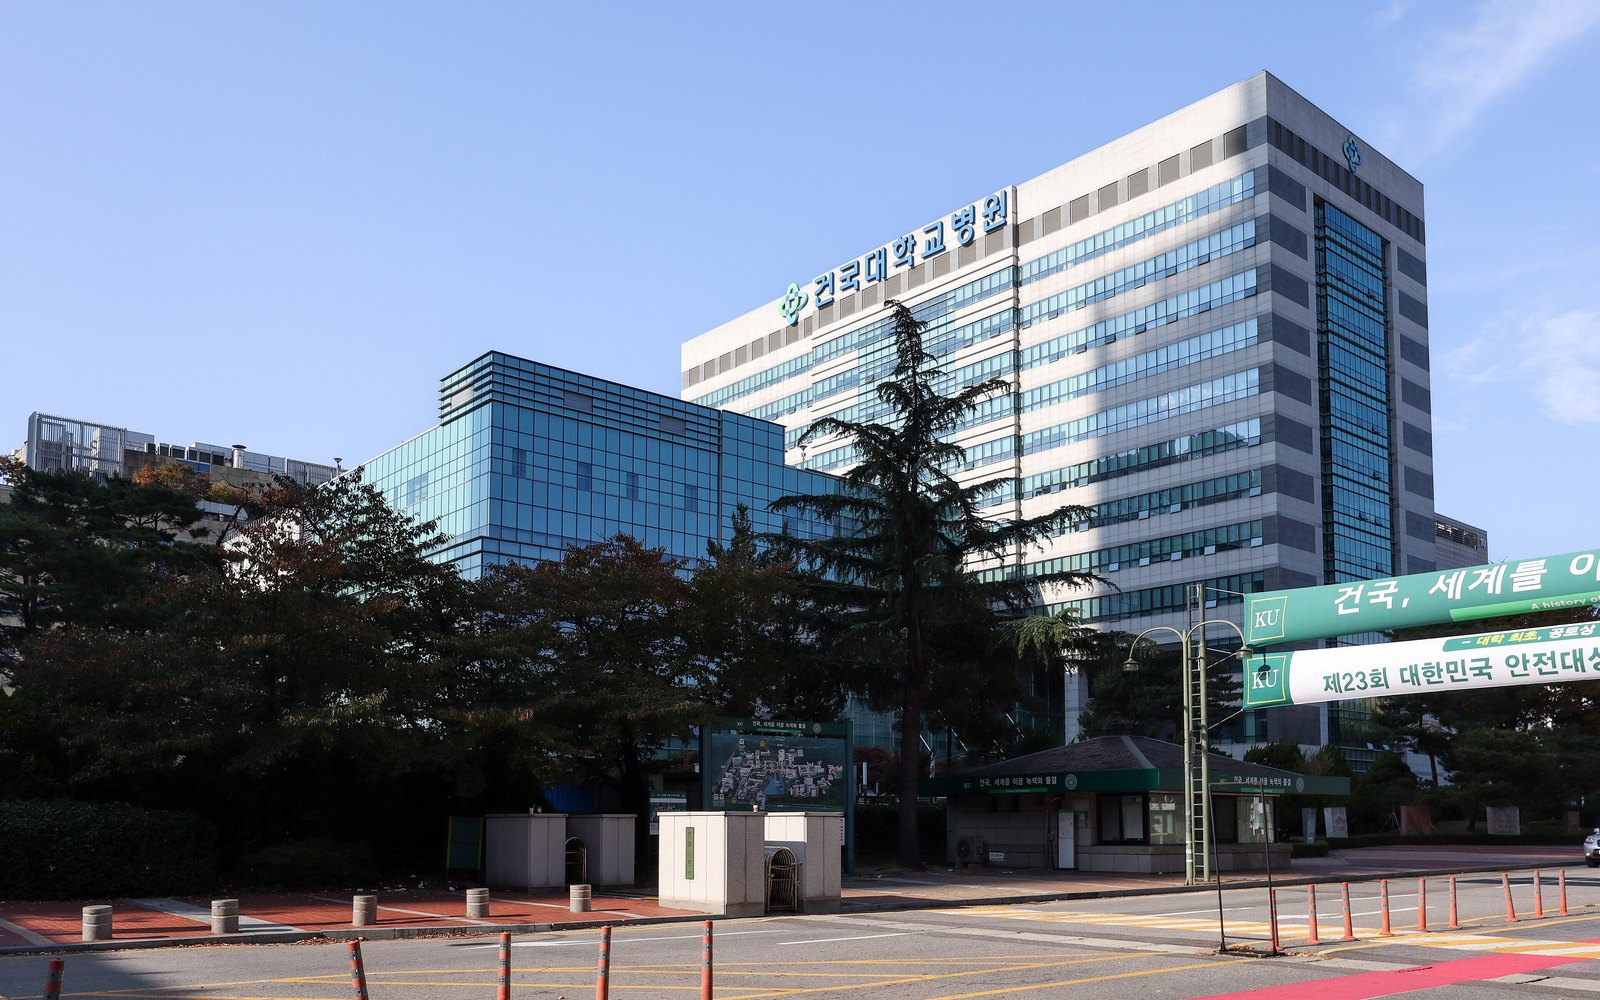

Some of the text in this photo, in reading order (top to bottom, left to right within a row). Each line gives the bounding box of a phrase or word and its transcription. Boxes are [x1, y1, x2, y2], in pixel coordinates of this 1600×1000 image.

[814, 190, 1008, 309] 건국대학교병원
[1334, 580, 1409, 616] 건국,
[1428, 559, 1548, 600] 세계를
[1531, 602, 1540, 610] A
[1543, 598, 1586, 609] history
[1254, 609, 1280, 628] KU
[1476, 634, 1505, 646] 대학
[1251, 669, 1279, 689] KU
[1323, 667, 1390, 694] 제23회
[1399, 657, 1493, 687] 대한민국
